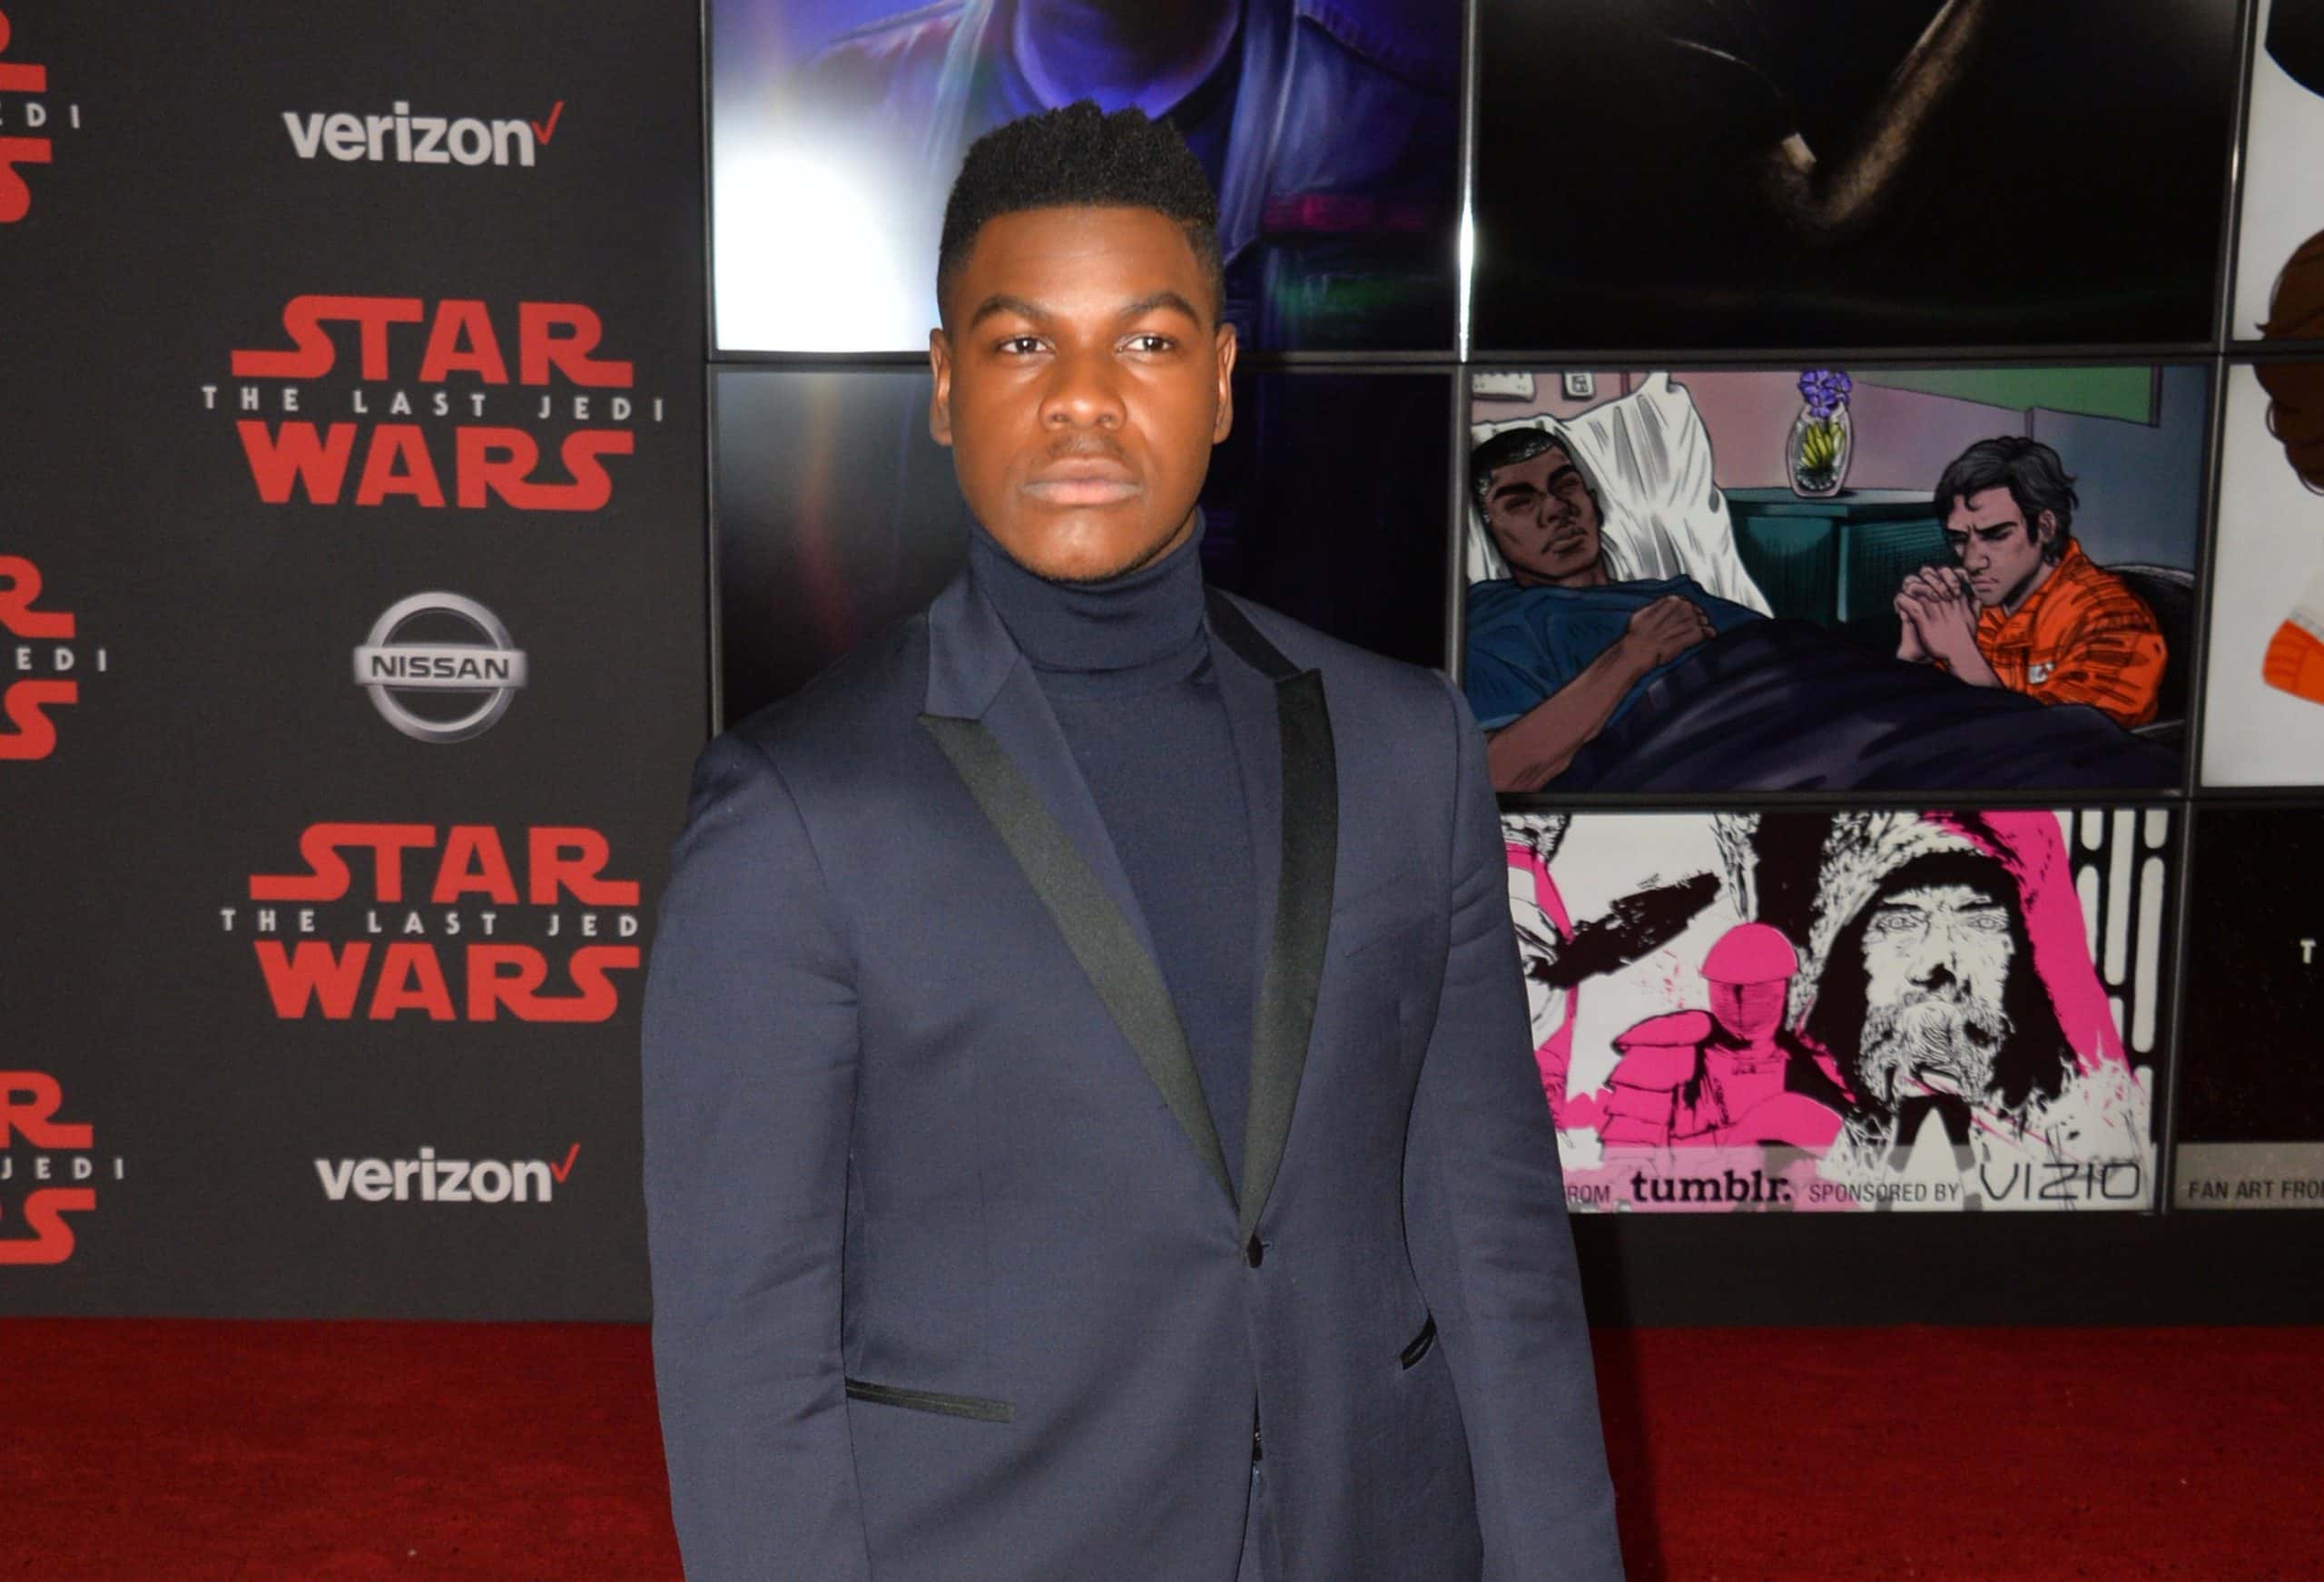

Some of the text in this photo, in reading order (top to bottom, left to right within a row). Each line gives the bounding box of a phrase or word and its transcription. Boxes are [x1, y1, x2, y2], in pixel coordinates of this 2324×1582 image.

[0, 102, 80, 129] DI
[282, 101, 536, 167] verizon
[231, 294, 633, 388] STAR
[202, 385, 663, 422] THE LAST JEDI
[236, 419, 635, 511] WARS
[371, 655, 510, 679] NISSAN
[249, 822, 640, 907] STAR
[221, 909, 639, 938] THE LAST JED
[253, 940, 640, 1023] WARS
[0, 1156, 123, 1180] JEDI
[314, 1146, 553, 1204] verizon
[1630, 1169, 1792, 1203] tumblr.
[1808, 1183, 1927, 1204] SPONSORED
[1934, 1183, 1960, 1203] BY
[1980, 1162, 2142, 1202] VIZIO
[2188, 1180, 2324, 1199] FAN ART FRO
